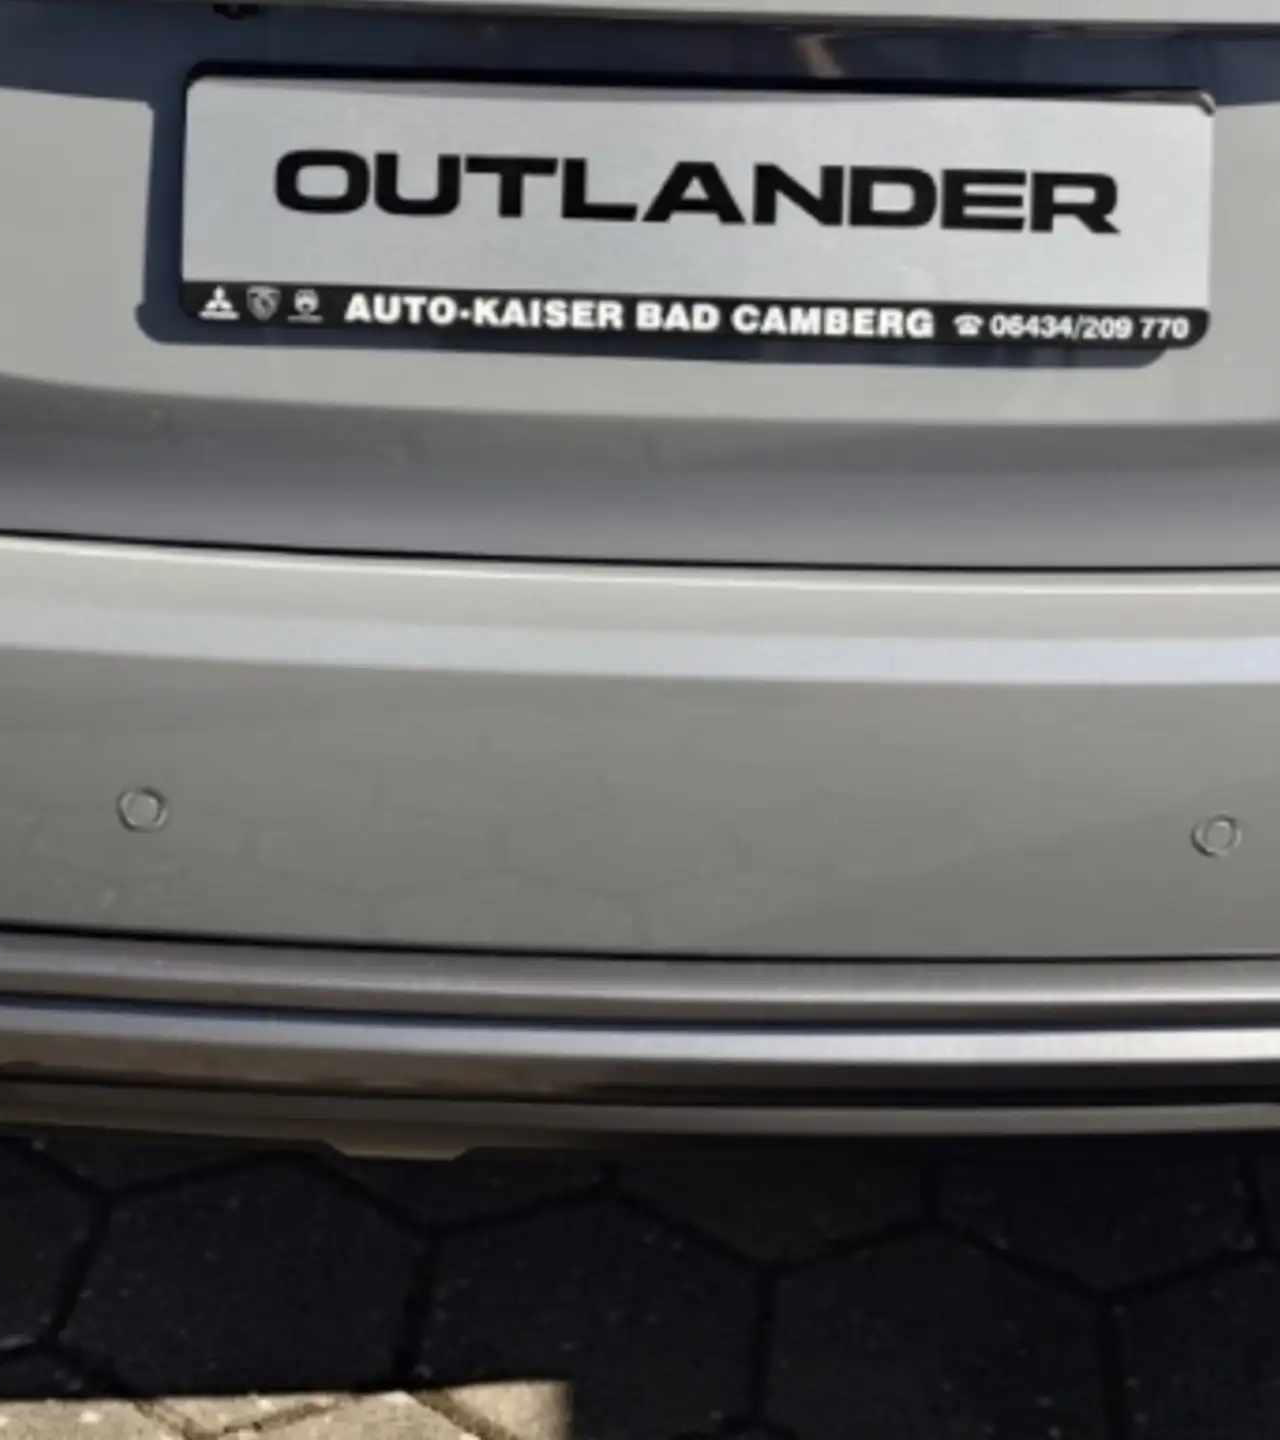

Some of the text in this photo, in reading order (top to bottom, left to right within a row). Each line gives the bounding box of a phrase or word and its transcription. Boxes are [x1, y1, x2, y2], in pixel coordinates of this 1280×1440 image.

[273, 148, 1120, 235] OUTLANDER
[344, 292, 625, 329] AUTO-KAISER
[635, 300, 719, 332] BAD
[732, 304, 935, 338] CAMBERG
[1140, 317, 1190, 340] 770
